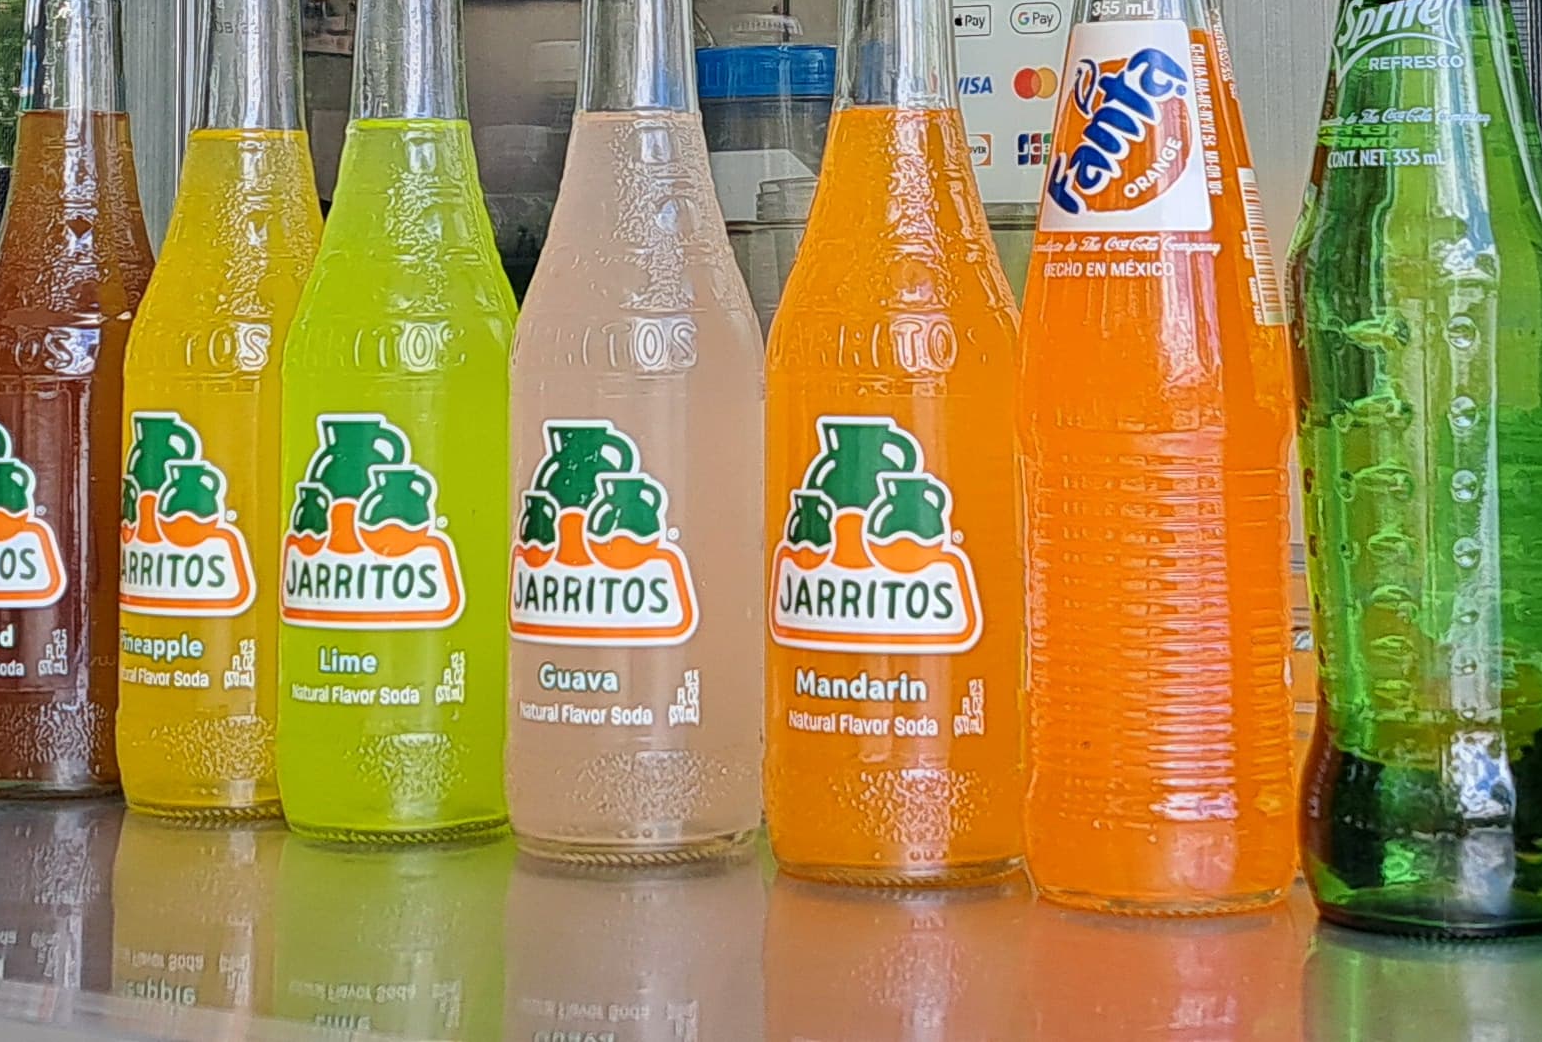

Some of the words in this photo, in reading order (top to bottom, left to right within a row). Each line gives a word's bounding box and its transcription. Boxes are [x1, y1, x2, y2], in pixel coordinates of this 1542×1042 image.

[965, 14, 986, 27] Pay
[1032, 12, 1054, 27] Pay
[1091, 2, 1120, 16] 355
[1126, 0, 1155, 15] mL
[1369, 55, 1464, 71] REFRESCO
[1047, 47, 1188, 215] Fanta
[1123, 136, 1183, 199] ORANGE
[1393, 148, 1420, 166] 355
[1423, 149, 1445, 166] mL
[1104, 236, 1159, 251] Coca-Cola
[1086, 263, 1106, 277] EN
[1110, 260, 1175, 277] MÉXICO
[286, 560, 438, 600] JARRITOS
[514, 571, 669, 614] JARRITOS
[780, 574, 954, 619] JARRITOS
[320, 647, 378, 673] Lime
[139, 667, 170, 685] Flavor
[174, 669, 210, 688] Soda
[539, 663, 619, 692] Guava
[795, 668, 928, 702] Mandarin
[292, 683, 329, 703] Natural
[332, 685, 376, 704] Flavor
[379, 686, 421, 706] Soda
[519, 701, 559, 722] Natural
[562, 704, 607, 725] Flavor
[611, 705, 654, 726] Soda
[789, 710, 836, 732] Natural
[840, 713, 890, 735] Flavor
[894, 715, 939, 737] Soda
